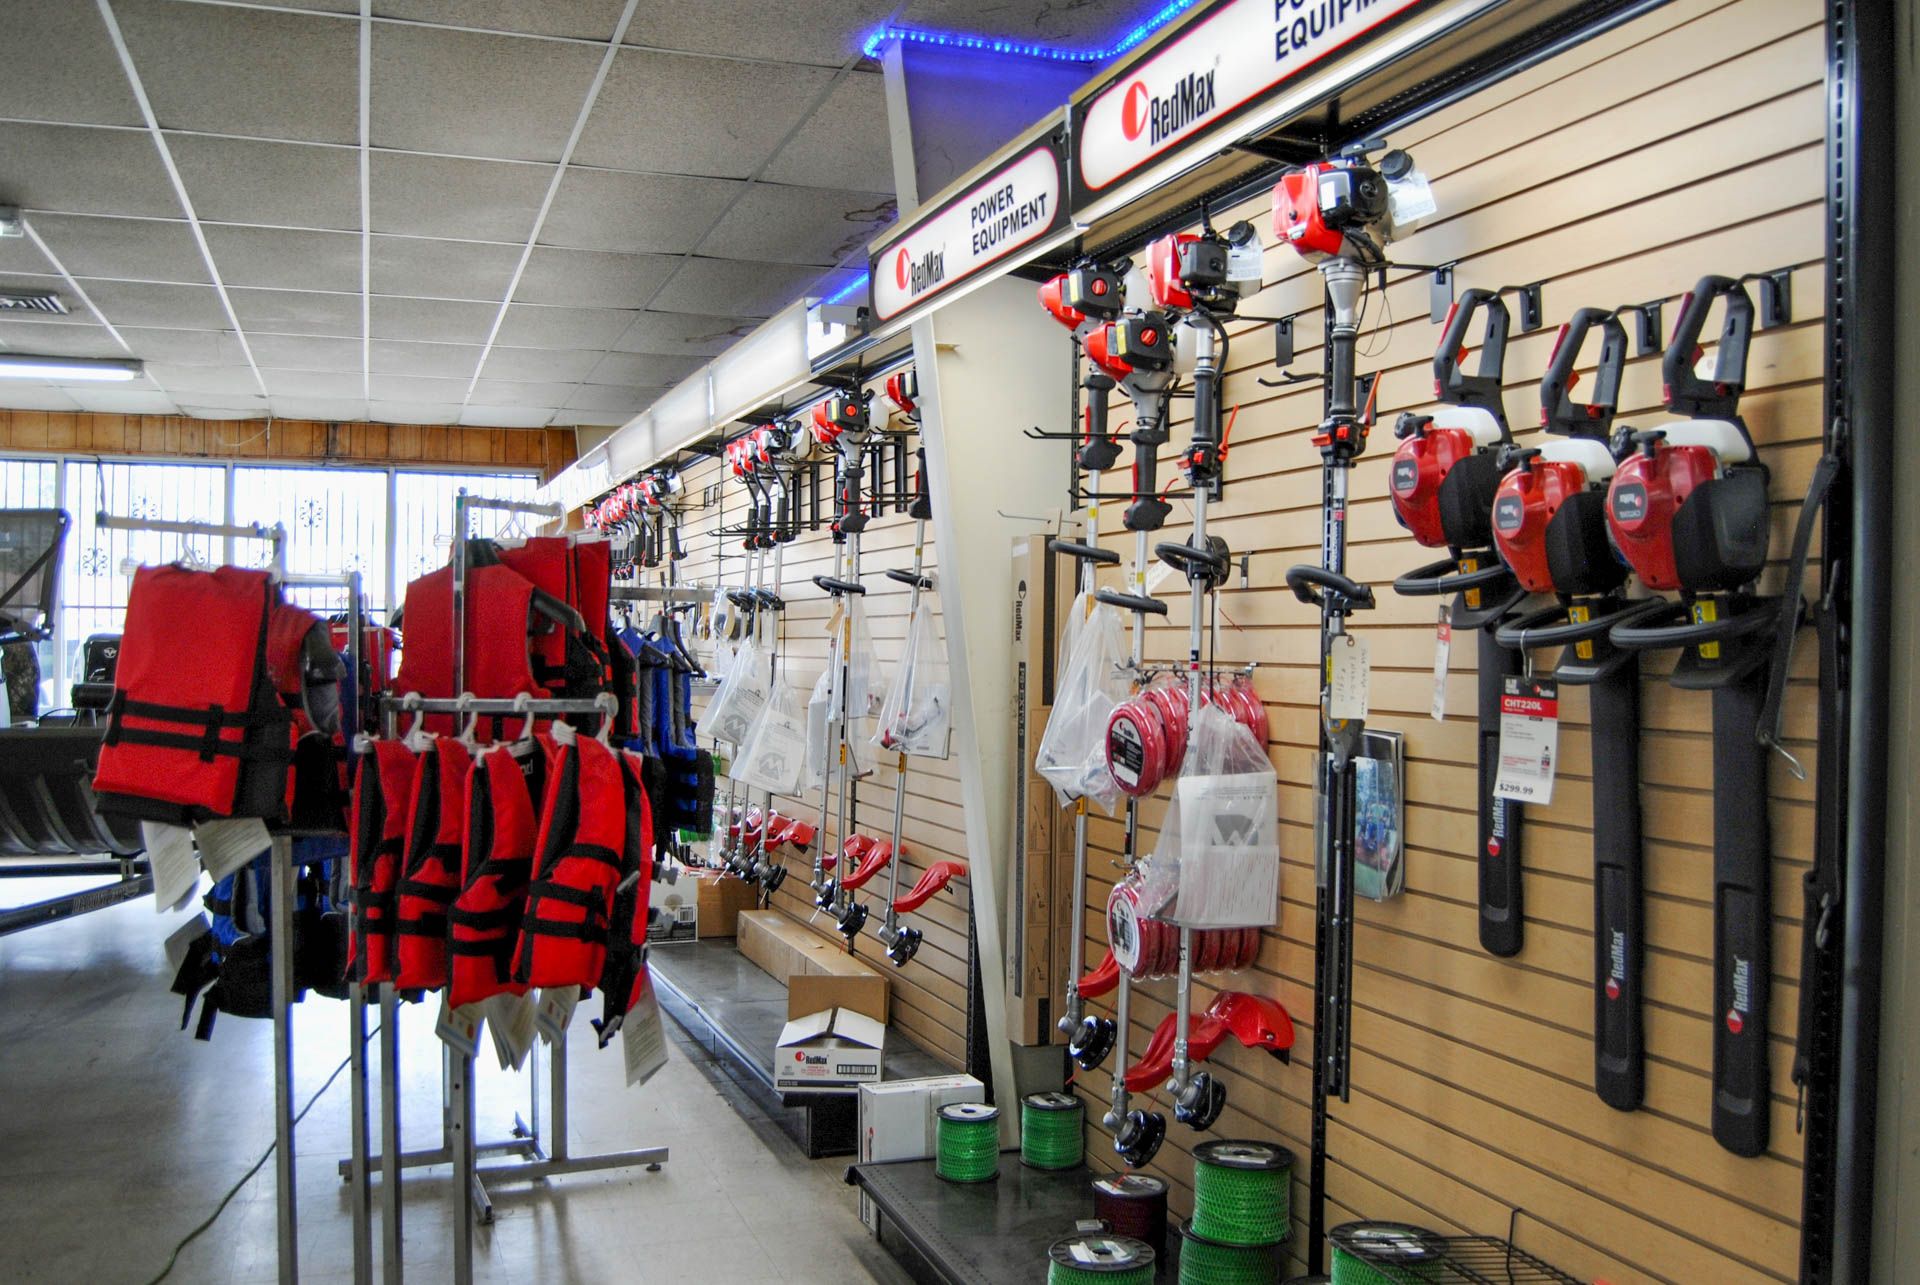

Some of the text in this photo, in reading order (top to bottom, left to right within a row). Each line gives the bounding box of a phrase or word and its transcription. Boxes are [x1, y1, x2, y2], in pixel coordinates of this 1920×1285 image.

[1151, 69, 1216, 146] RedMax
[971, 184, 1015, 228] POWER
[972, 192, 1047, 256] EQUIPMENT
[911, 250, 945, 296] RedMax
[1015, 600, 1023, 642] RedMax
[1504, 698, 1543, 711] CHT220L
[1499, 783, 1534, 795] $299.99
[1610, 930, 1625, 980] RedMax
[1733, 958, 1749, 1012] RedMax
[806, 1056, 827, 1064] RedMax
